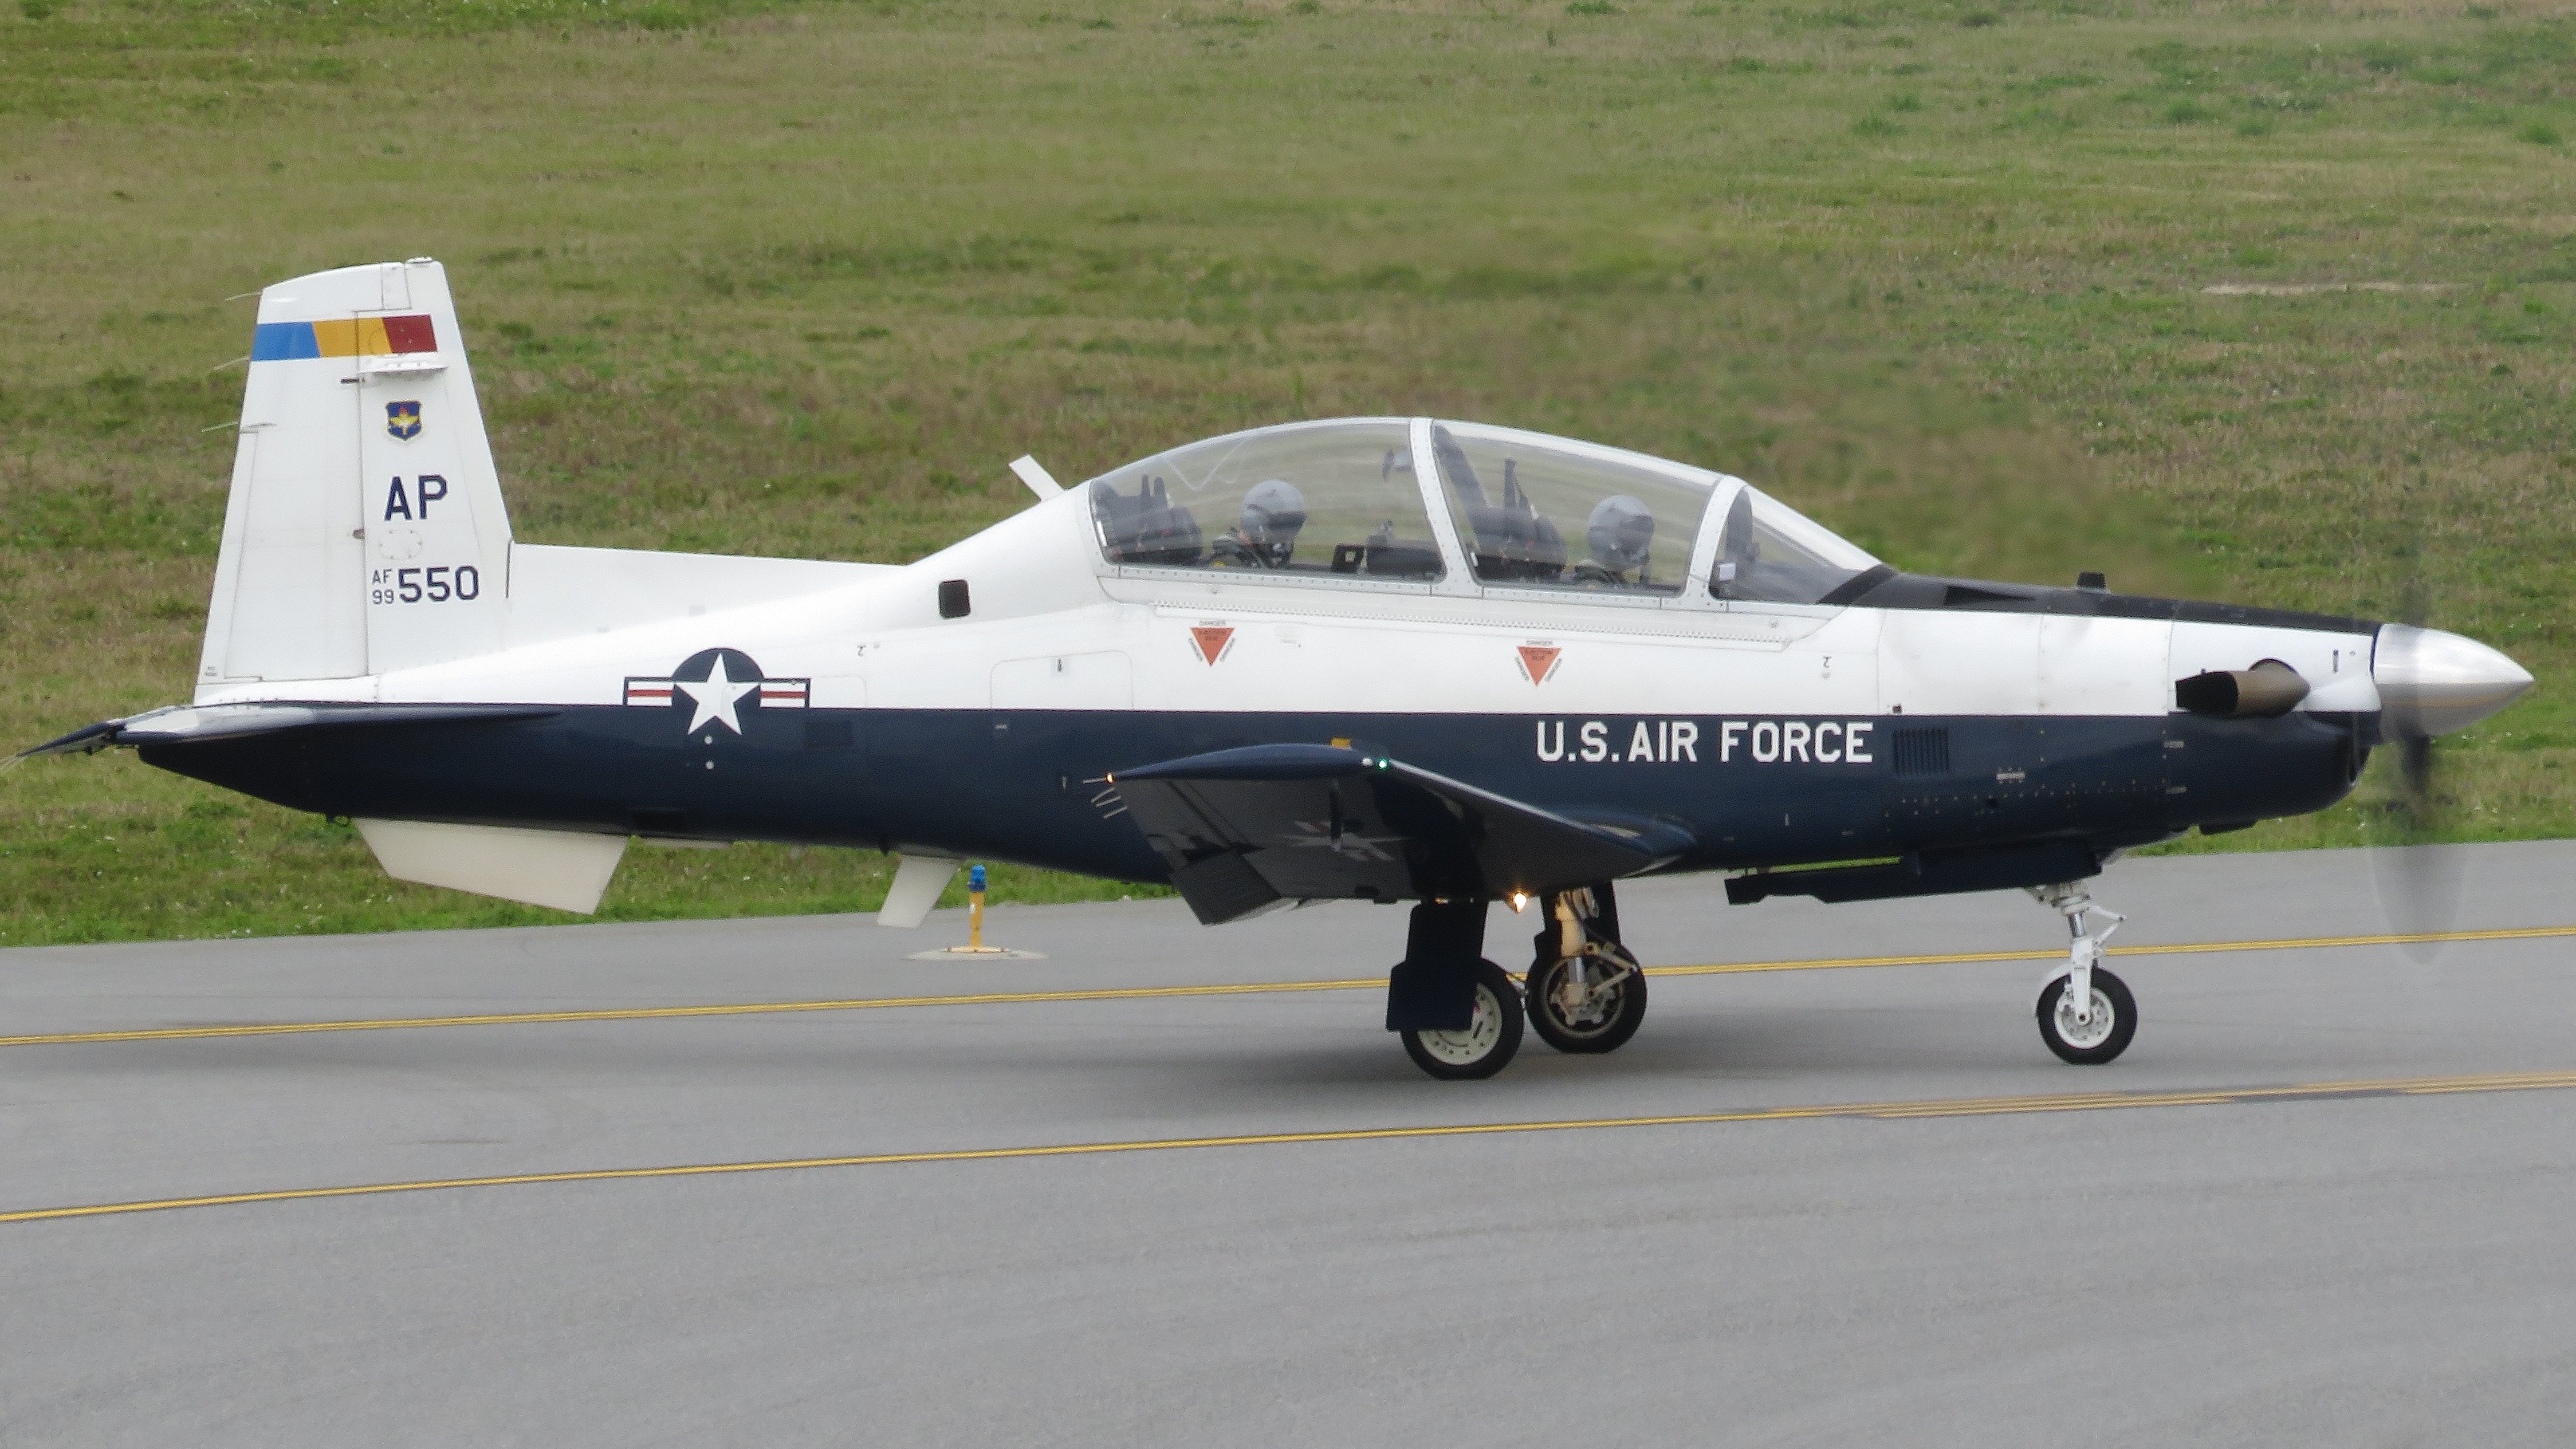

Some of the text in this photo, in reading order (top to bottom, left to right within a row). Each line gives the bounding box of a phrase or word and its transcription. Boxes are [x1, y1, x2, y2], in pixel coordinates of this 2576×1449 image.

[384, 475, 447, 521] AP
[372, 569, 392, 584] AF
[398, 565, 479, 603] 550
[372, 589, 394, 604] 99
[1537, 720, 1874, 764] U.S. AIR FORCE
